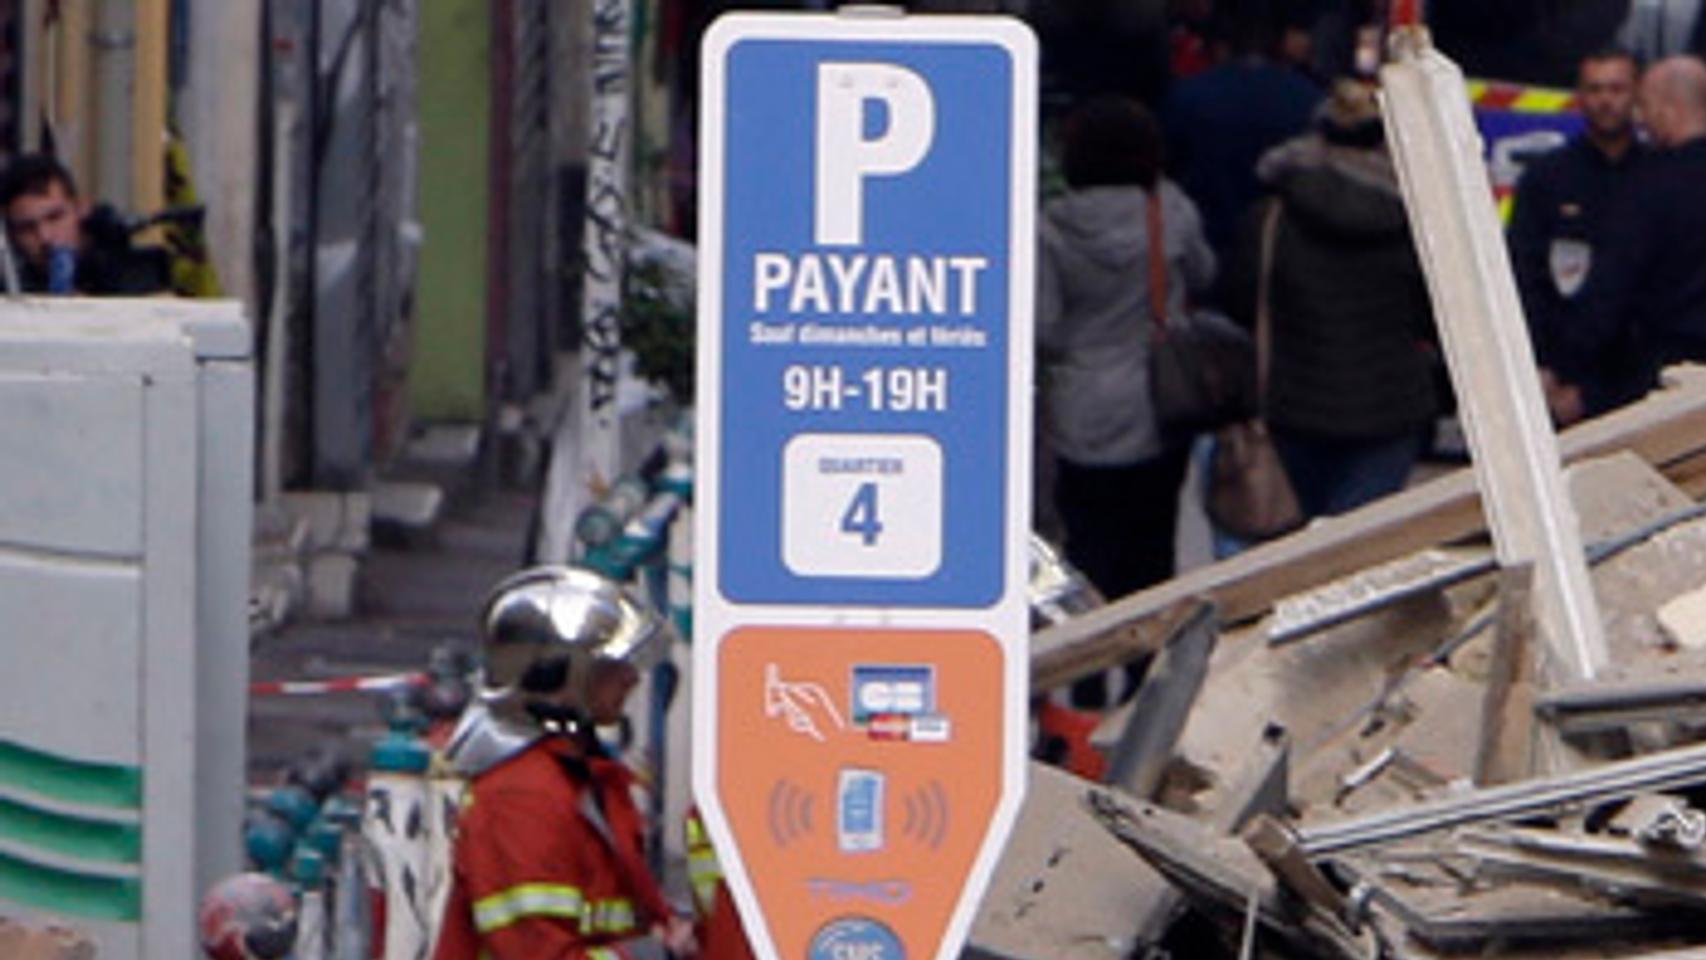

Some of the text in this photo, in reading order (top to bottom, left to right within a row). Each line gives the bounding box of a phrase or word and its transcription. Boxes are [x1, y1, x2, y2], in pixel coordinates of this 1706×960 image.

[814, 61, 936, 246] P
[753, 254, 986, 315] PAYANT
[783, 365, 948, 412] 9H-19H
[819, 458, 904, 474] QUARTIER
[840, 483, 884, 546] 4
